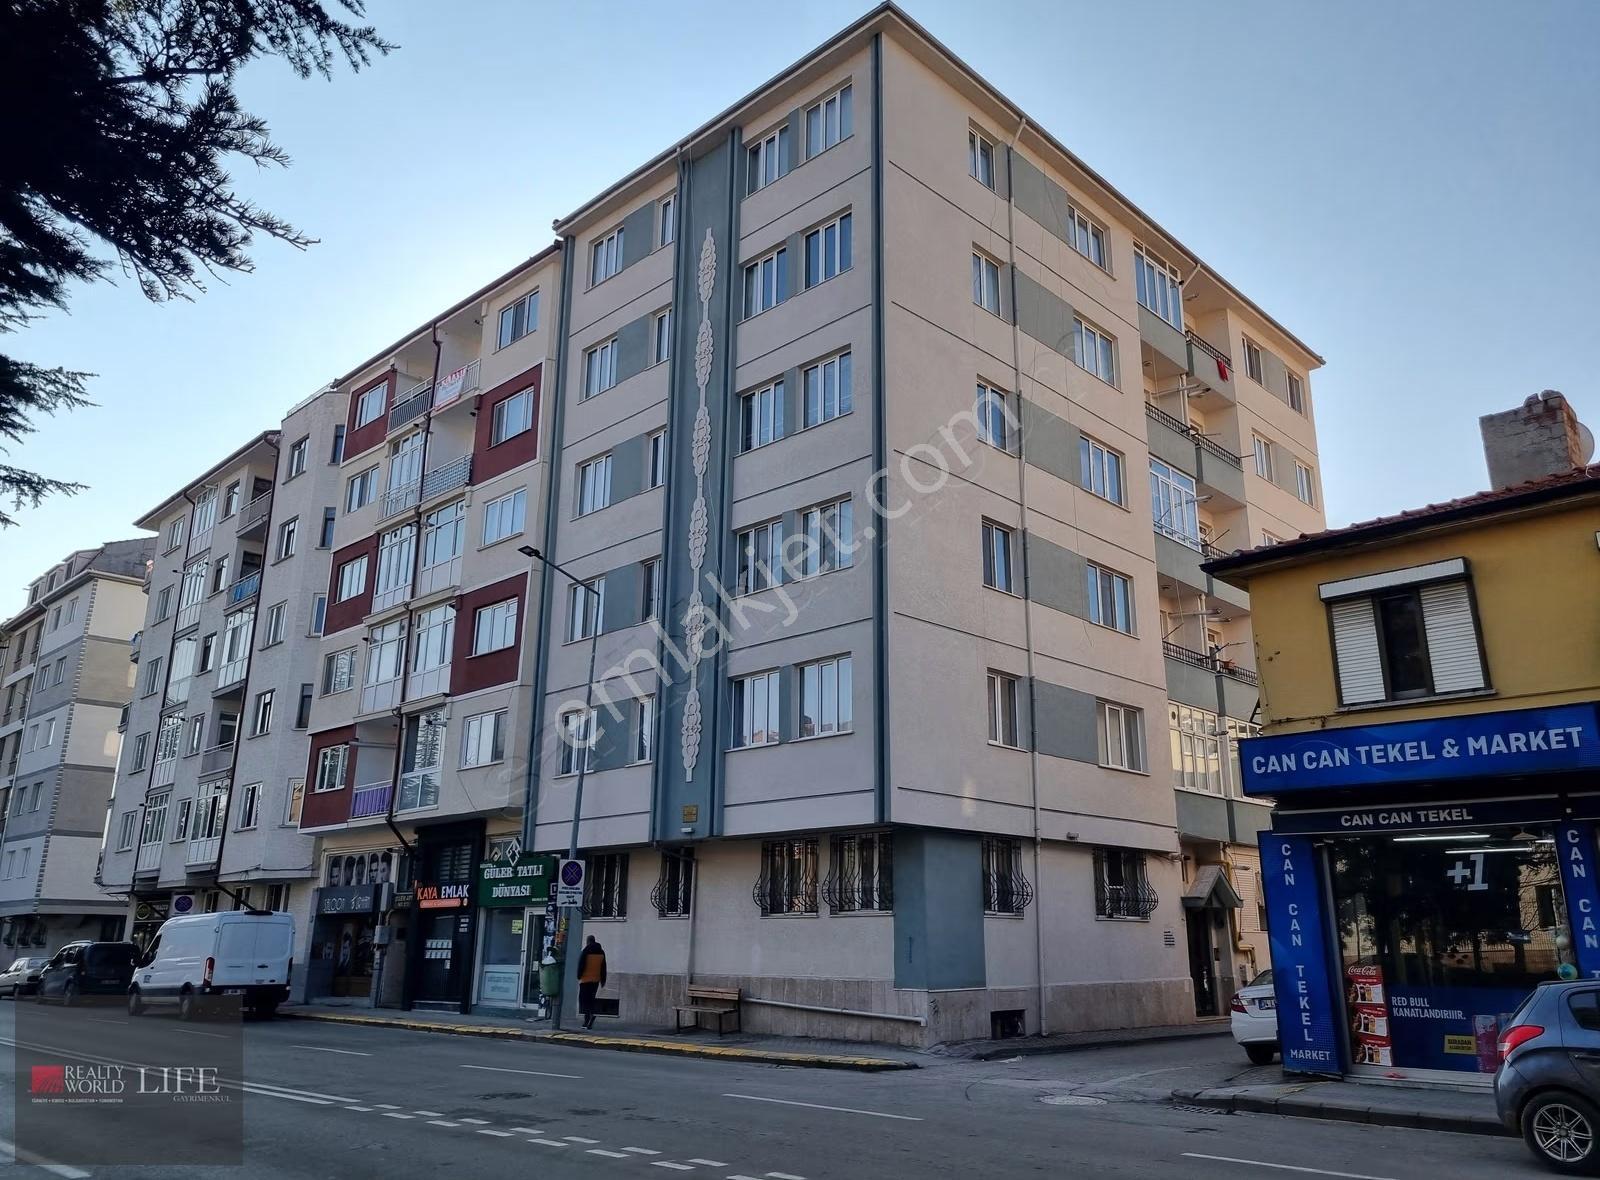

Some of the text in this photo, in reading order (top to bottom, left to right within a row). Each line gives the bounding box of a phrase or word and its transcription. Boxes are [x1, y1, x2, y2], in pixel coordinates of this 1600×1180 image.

[1252, 726, 1583, 774] CAN CAN TEKEL & MARKET
[1340, 808, 1473, 827] CAN CAN TEKEL
[484, 864, 513, 879] GÜLER
[517, 864, 544, 877] TATLI
[1446, 853, 1489, 891] +1
[417, 884, 470, 900] KAYA EMLAK
[491, 883, 531, 898] DÜNYASI
[1567, 829, 1586, 878] CAN
[1578, 898, 1599, 949] CAN
[1281, 843, 1314, 1042] CAN CAN TEKEL
[1391, 996, 1430, 1007] RED BULL
[1290, 1048, 1331, 1062] MARKET
